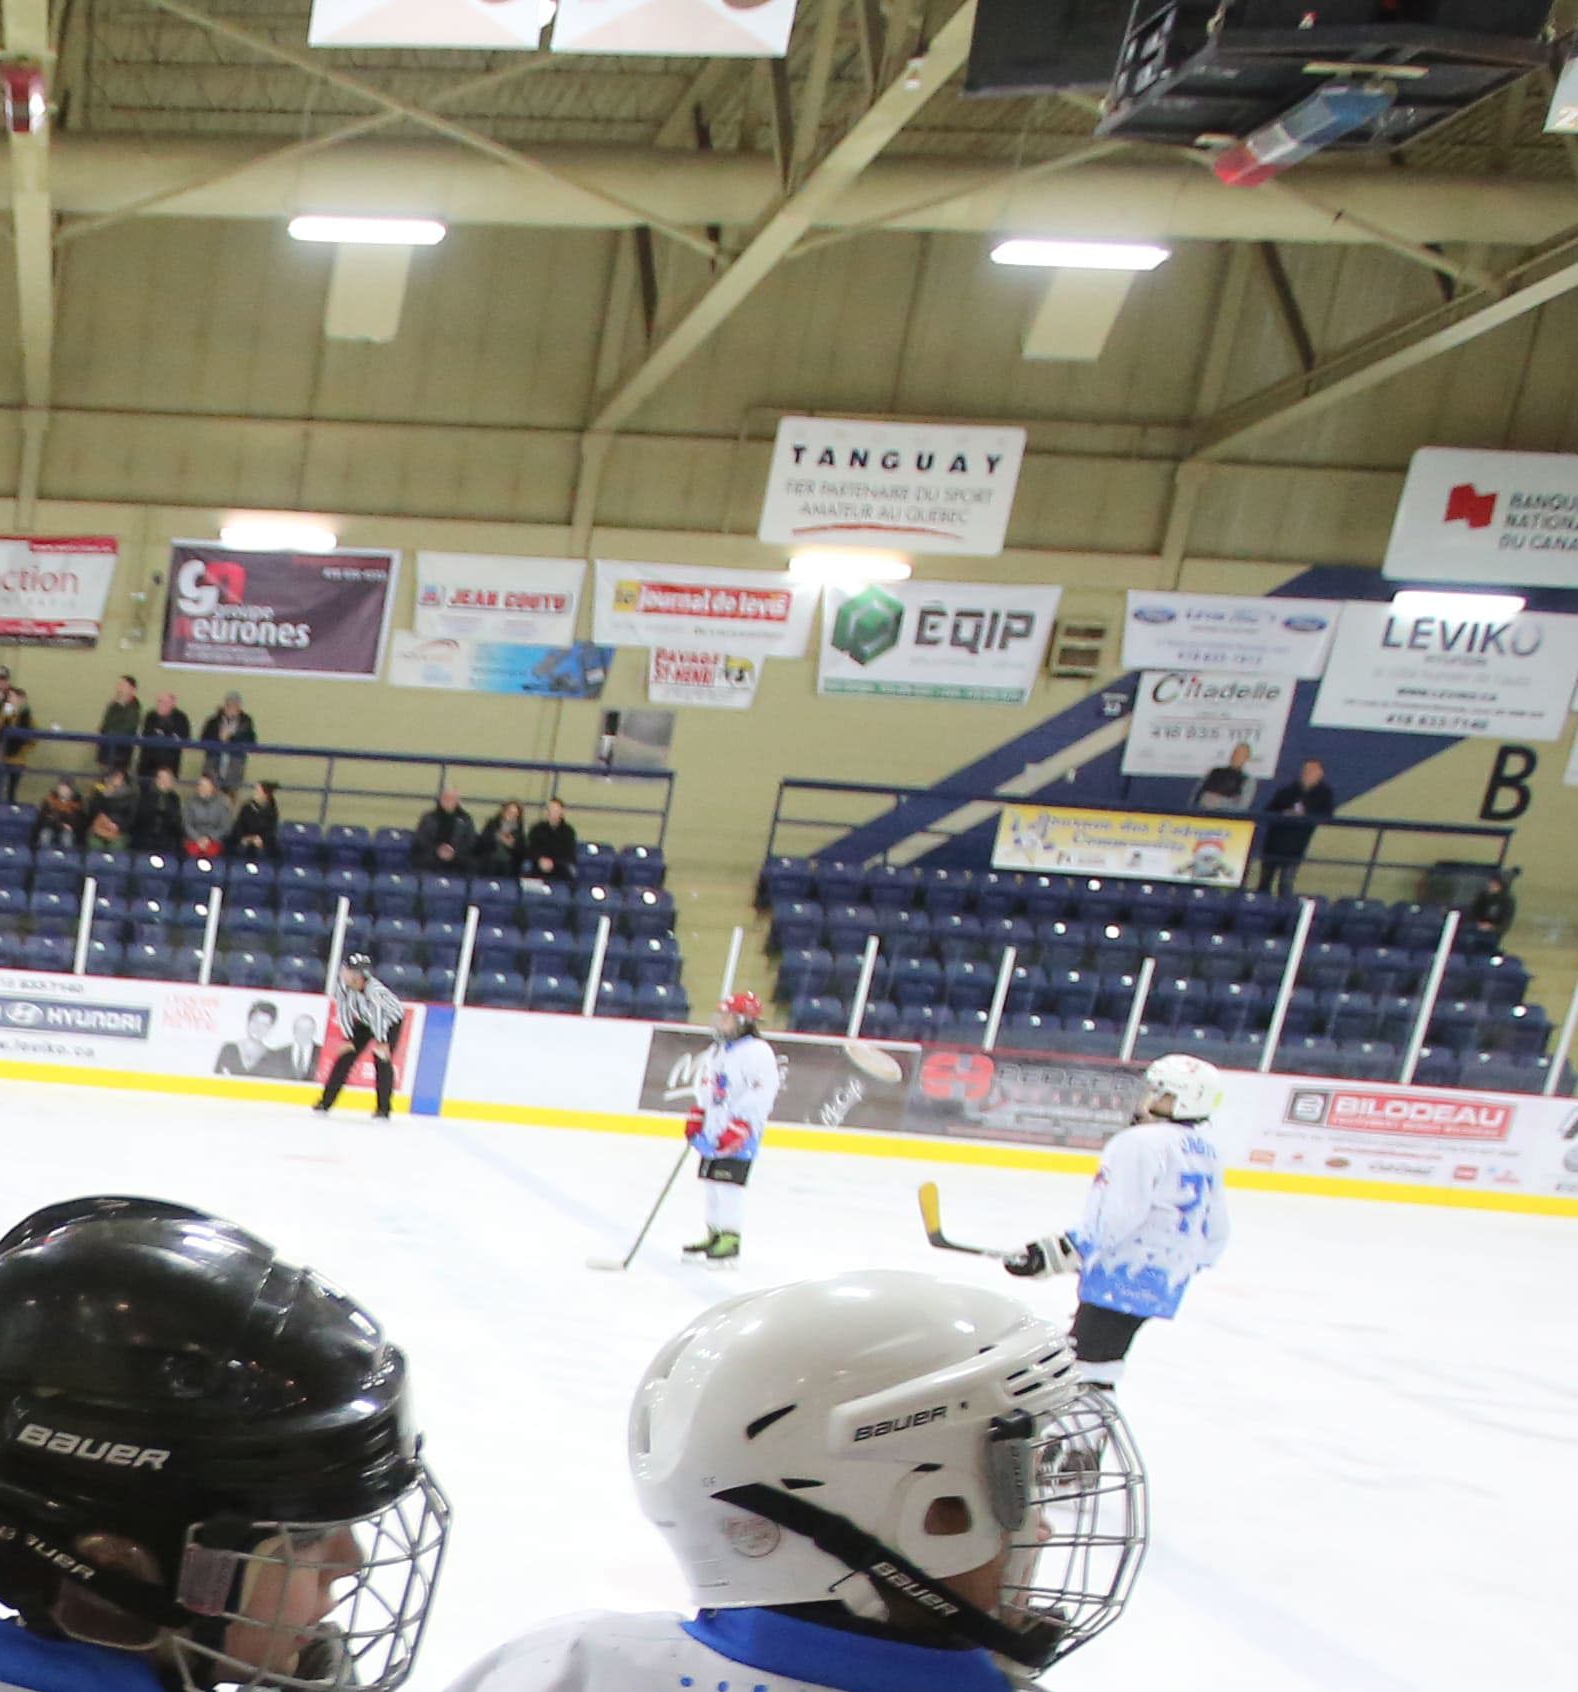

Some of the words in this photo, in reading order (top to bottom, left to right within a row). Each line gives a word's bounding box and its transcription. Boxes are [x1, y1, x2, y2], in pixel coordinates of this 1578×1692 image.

[792, 444, 1003, 475] TANGUAY
[448, 588, 497, 608] JEAN
[504, 591, 568, 612] COUTU
[174, 617, 311, 649] neurones
[1381, 614, 1542, 656] LEVIKO
[1152, 673, 1281, 703] Citadelle
[1479, 744, 1538, 822] B
[46, 1007, 142, 1034] HYUNDAI
[1334, 1096, 1506, 1127] BILODEAU
[853, 1405, 948, 1442] BAUER
[16, 1422, 172, 1470] BAUER
[870, 1560, 960, 1616] BAUER
